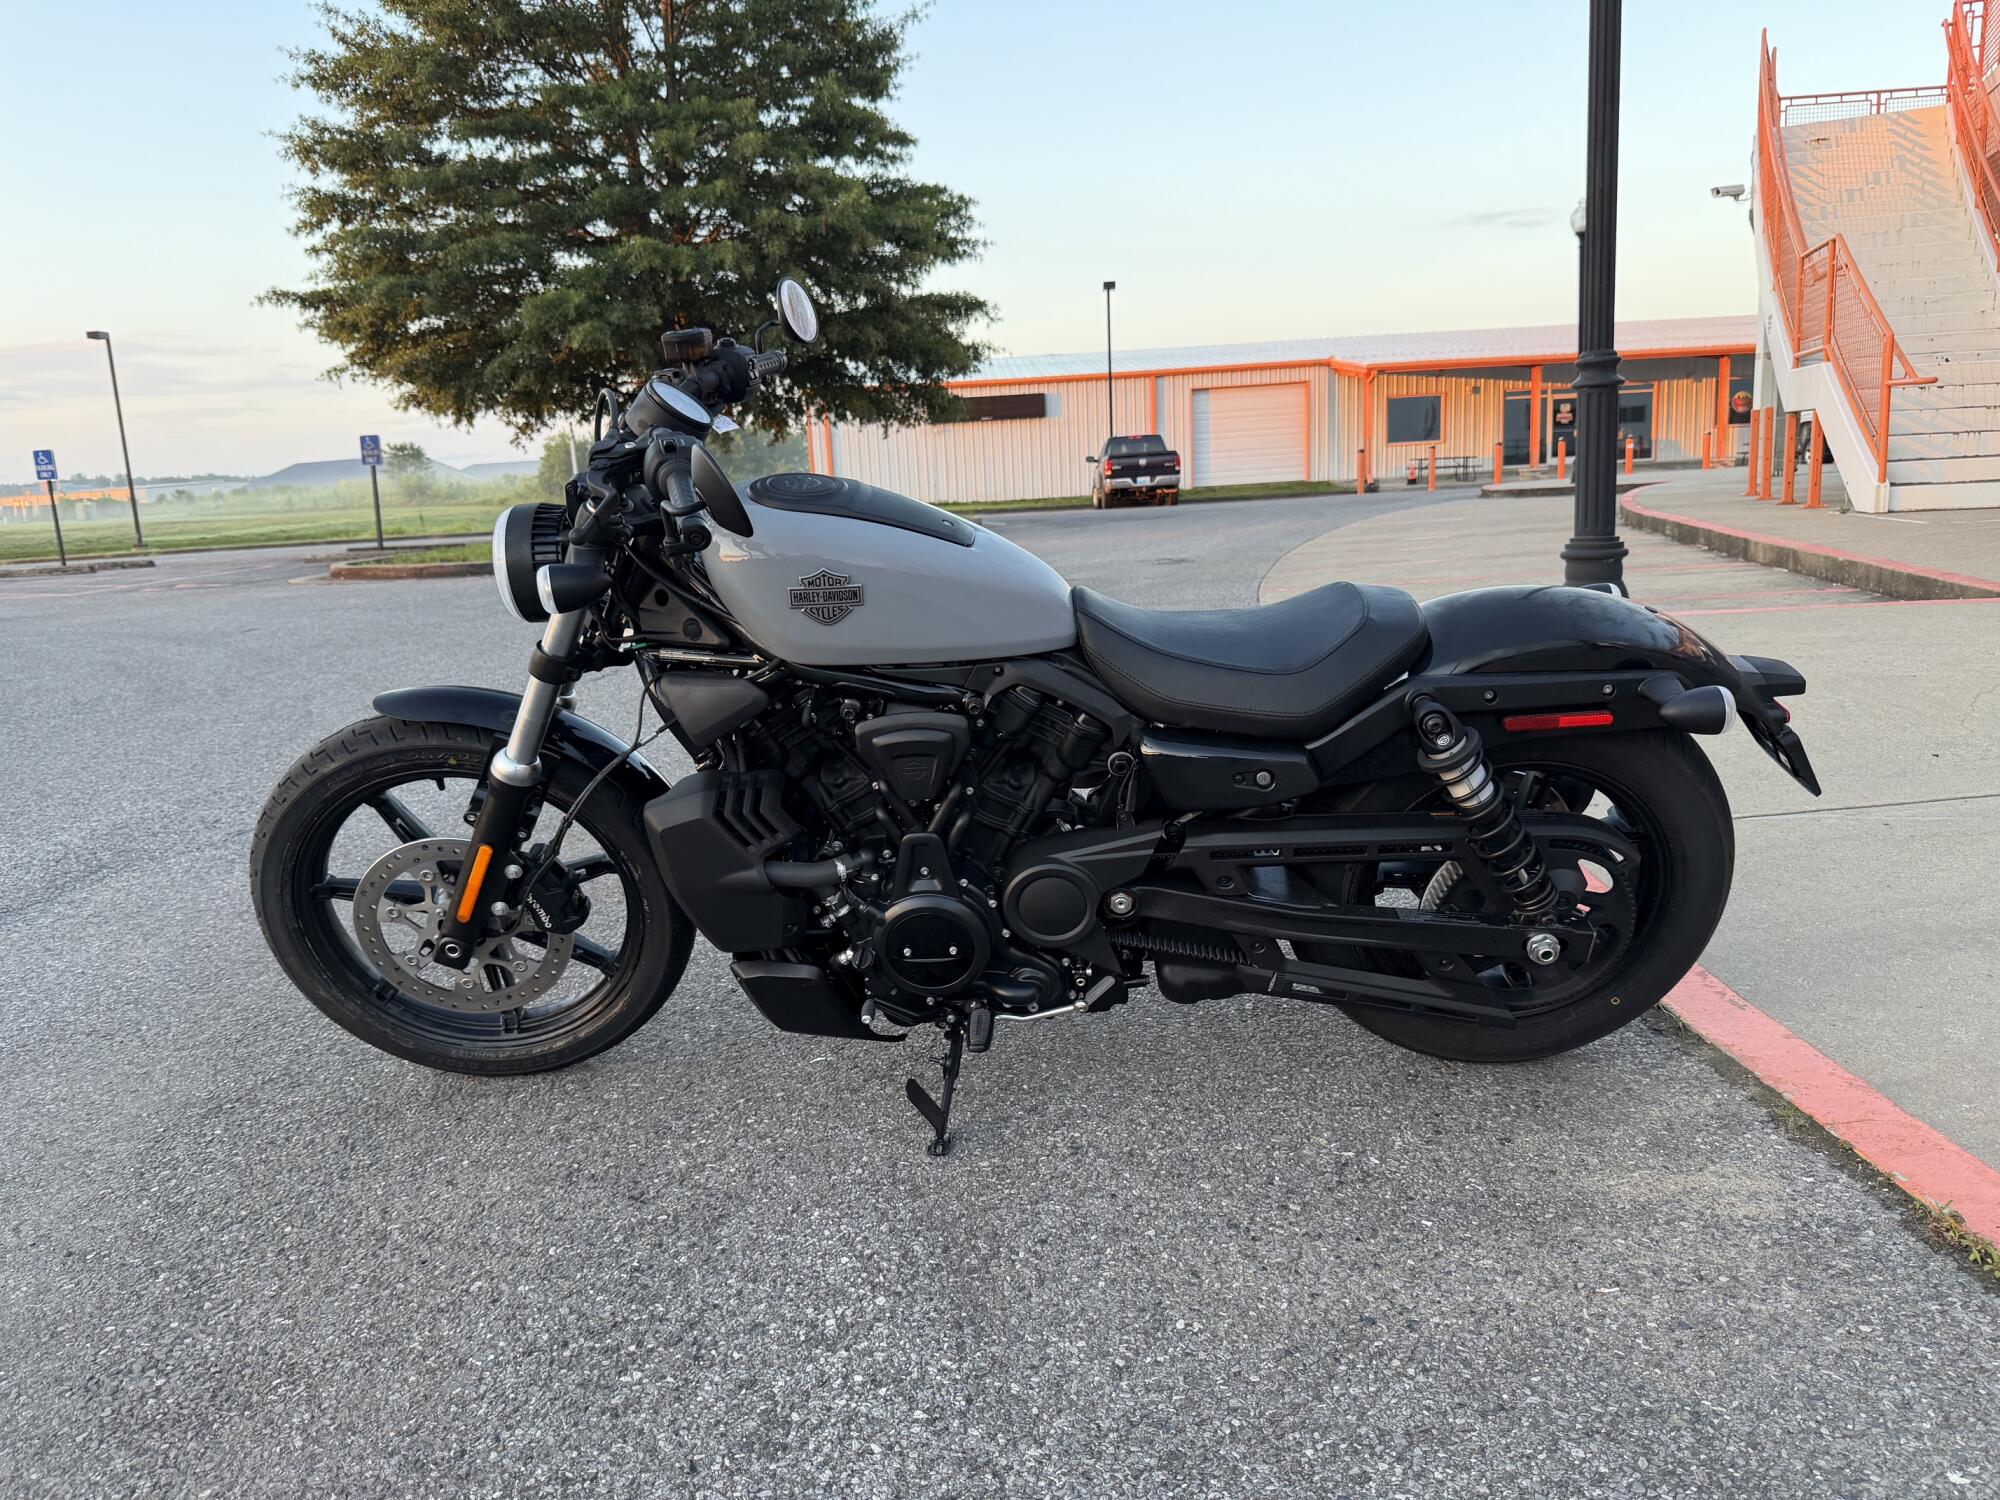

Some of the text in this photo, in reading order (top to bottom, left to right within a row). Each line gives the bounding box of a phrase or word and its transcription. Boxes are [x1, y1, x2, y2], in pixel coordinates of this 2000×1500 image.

[807, 574, 842, 588] MOTOR
[793, 588, 859, 603] HARLEY-DAVIDSON
[810, 605, 845, 620] CYCLES
